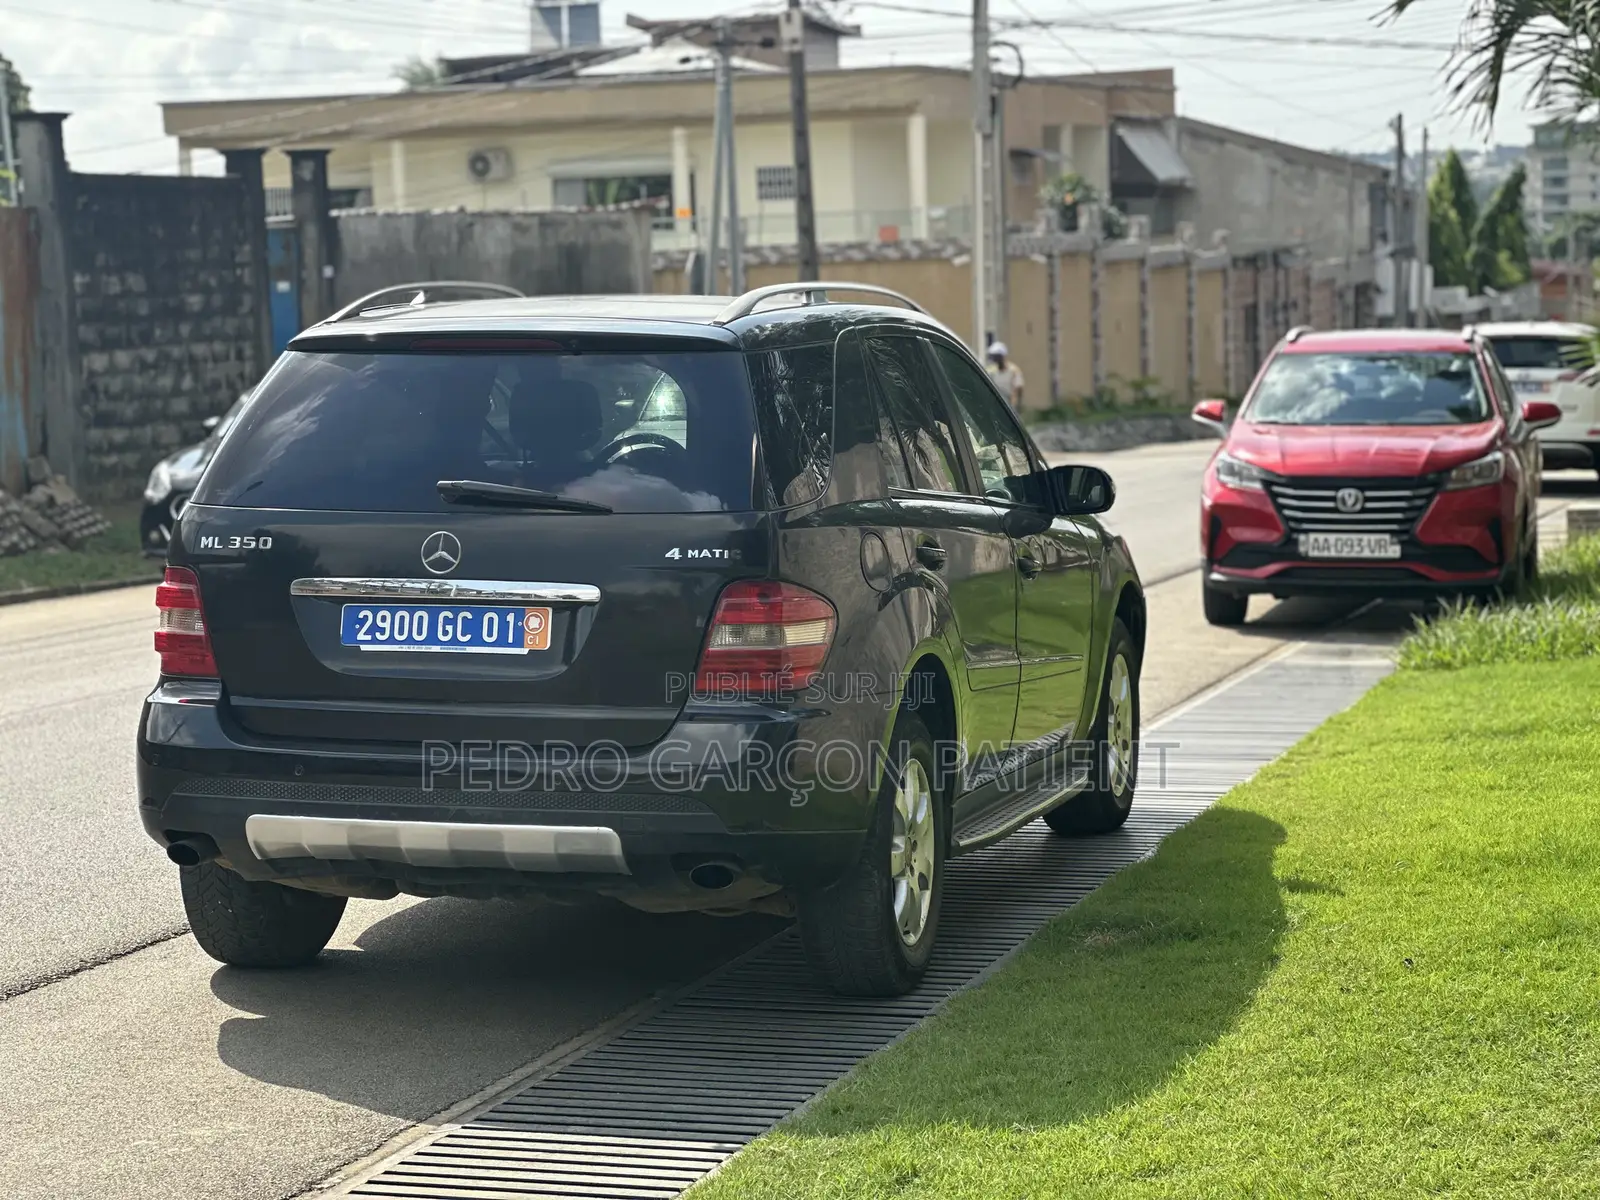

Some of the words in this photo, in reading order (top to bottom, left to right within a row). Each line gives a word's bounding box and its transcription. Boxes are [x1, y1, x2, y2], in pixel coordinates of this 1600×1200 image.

[200, 536, 223, 549] ML
[228, 536, 272, 549] 350
[665, 547, 682, 560] 4
[356, 610, 428, 641] 2900
[437, 611, 473, 642] GC
[482, 612, 515, 643] 01
[527, 635, 539, 645] CI
